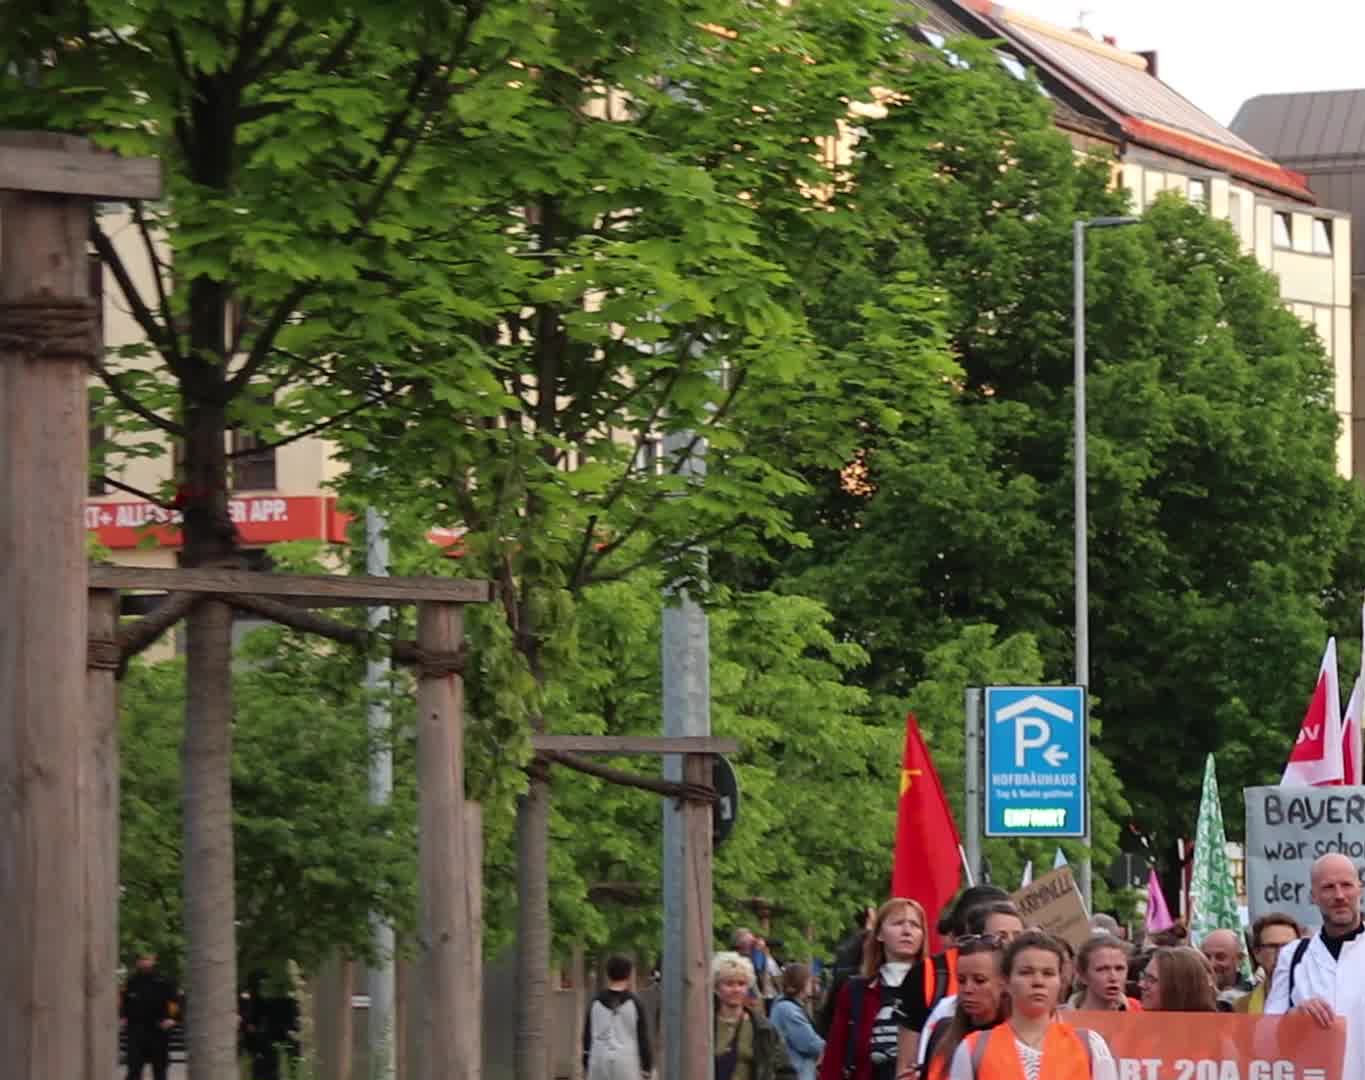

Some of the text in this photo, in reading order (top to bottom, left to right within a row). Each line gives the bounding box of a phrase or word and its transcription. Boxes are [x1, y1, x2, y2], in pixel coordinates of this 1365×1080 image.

[250, 499, 288, 522] APP.
[1015, 717, 1050, 767] P
[1264, 844, 1309, 860] war
[1264, 875, 1305, 904] der
